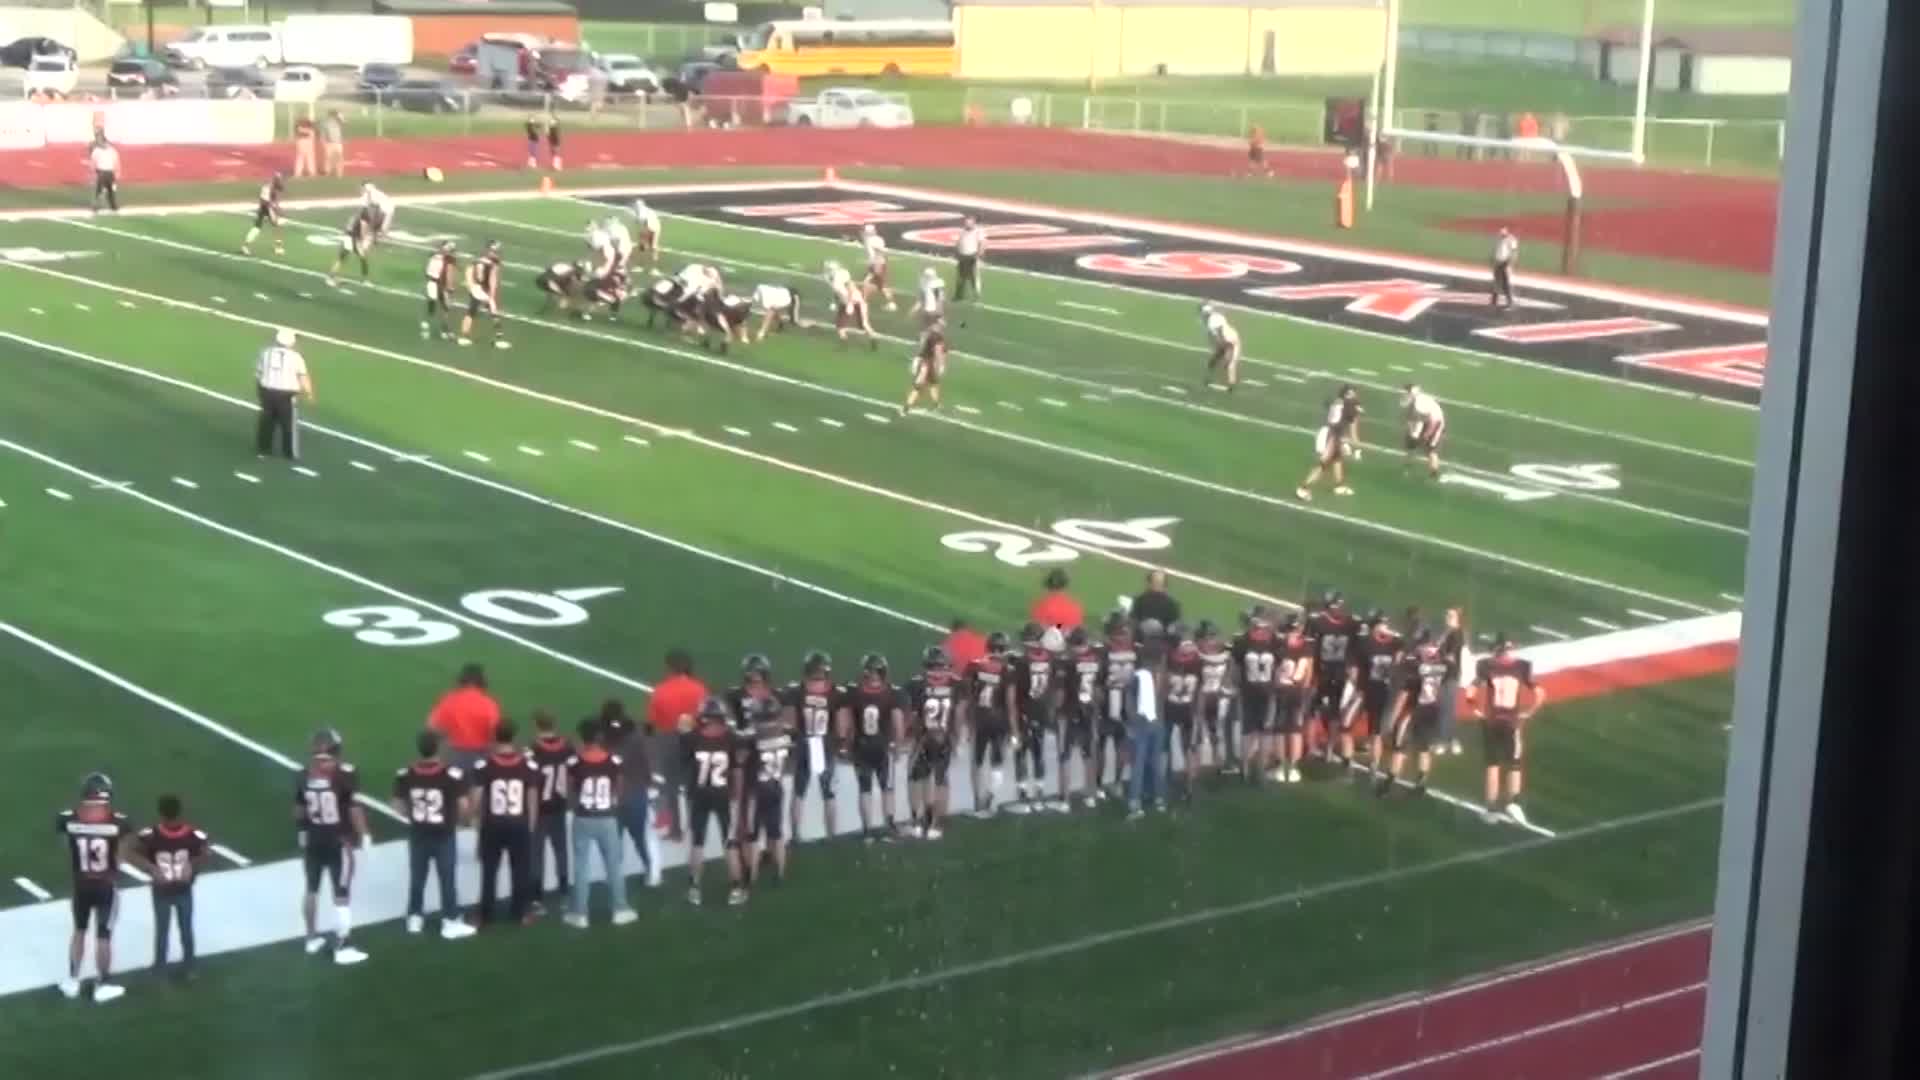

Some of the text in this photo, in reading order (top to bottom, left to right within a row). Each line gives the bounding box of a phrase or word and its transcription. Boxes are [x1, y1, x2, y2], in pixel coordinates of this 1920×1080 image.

[941, 516, 1178, 568] 20
[323, 587, 600, 647] 30
[695, 751, 729, 786] 72
[490, 779, 524, 815] 69
[76, 837, 109, 872] 13
